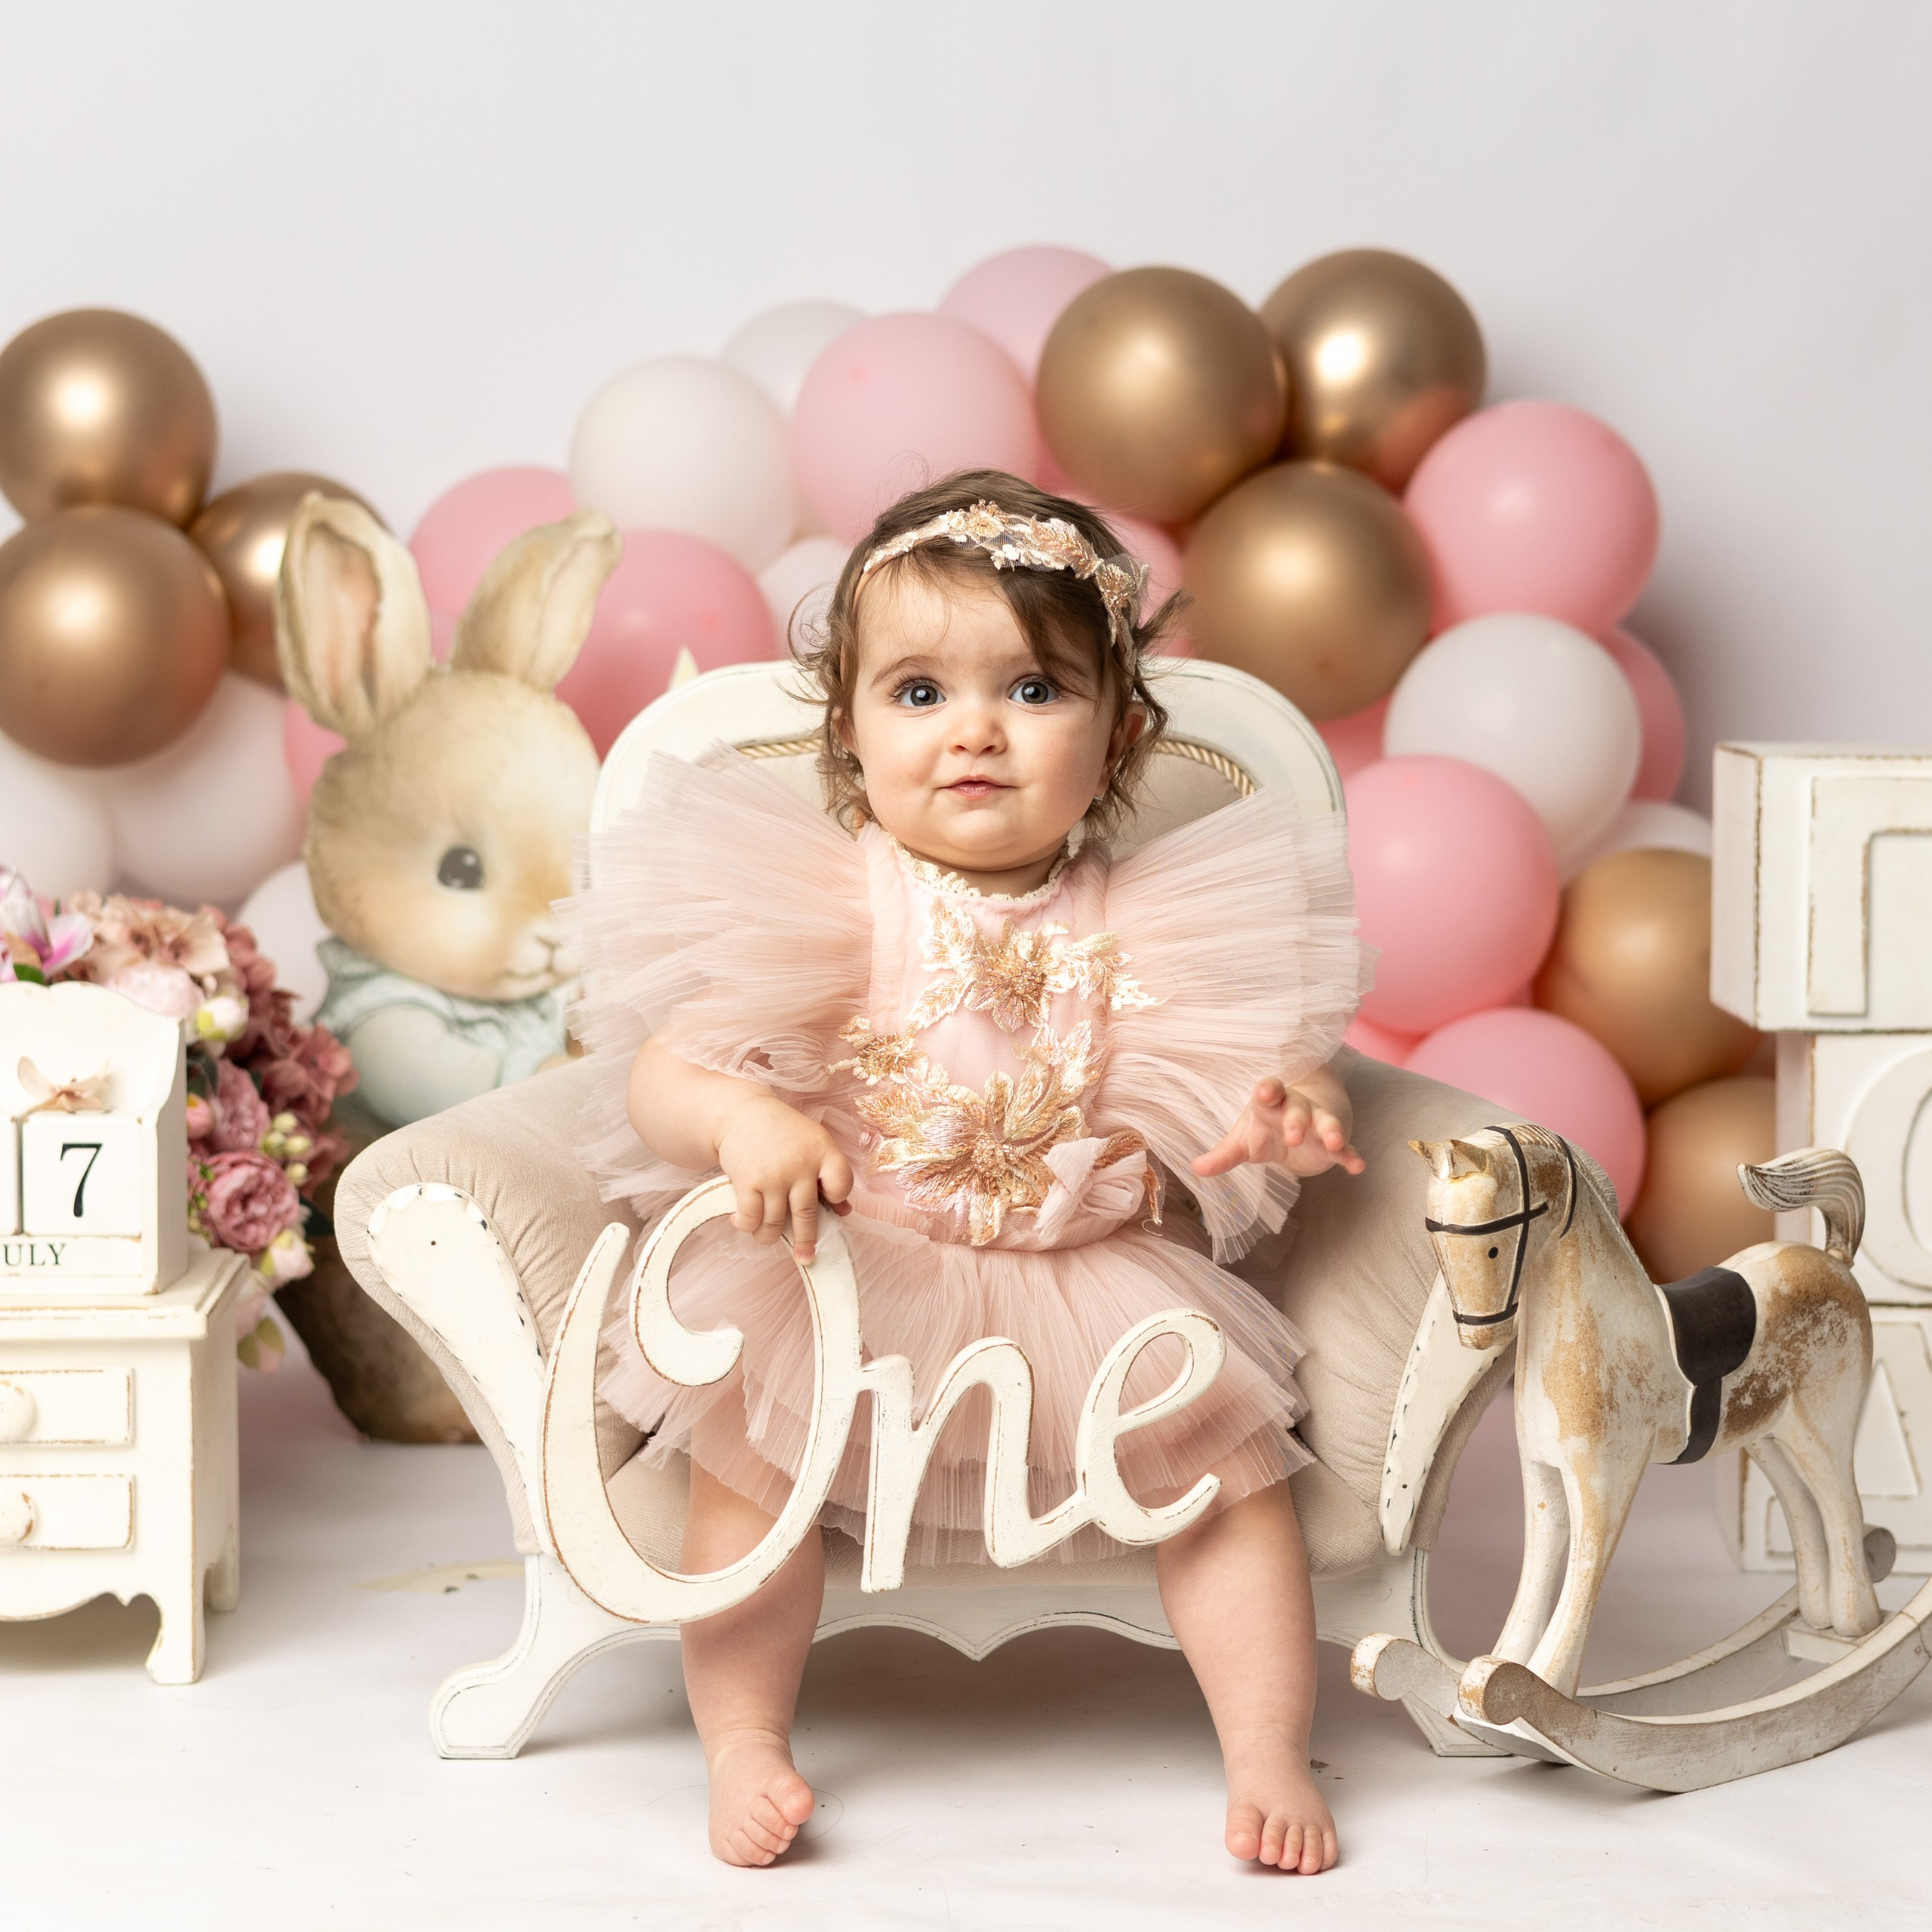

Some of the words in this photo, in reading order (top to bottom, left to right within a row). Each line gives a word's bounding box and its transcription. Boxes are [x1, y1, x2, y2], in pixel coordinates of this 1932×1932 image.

[60, 1143, 103, 1217] 7
[2, 1243, 66, 1266] ULY
[537, 1174, 1226, 1624] One
